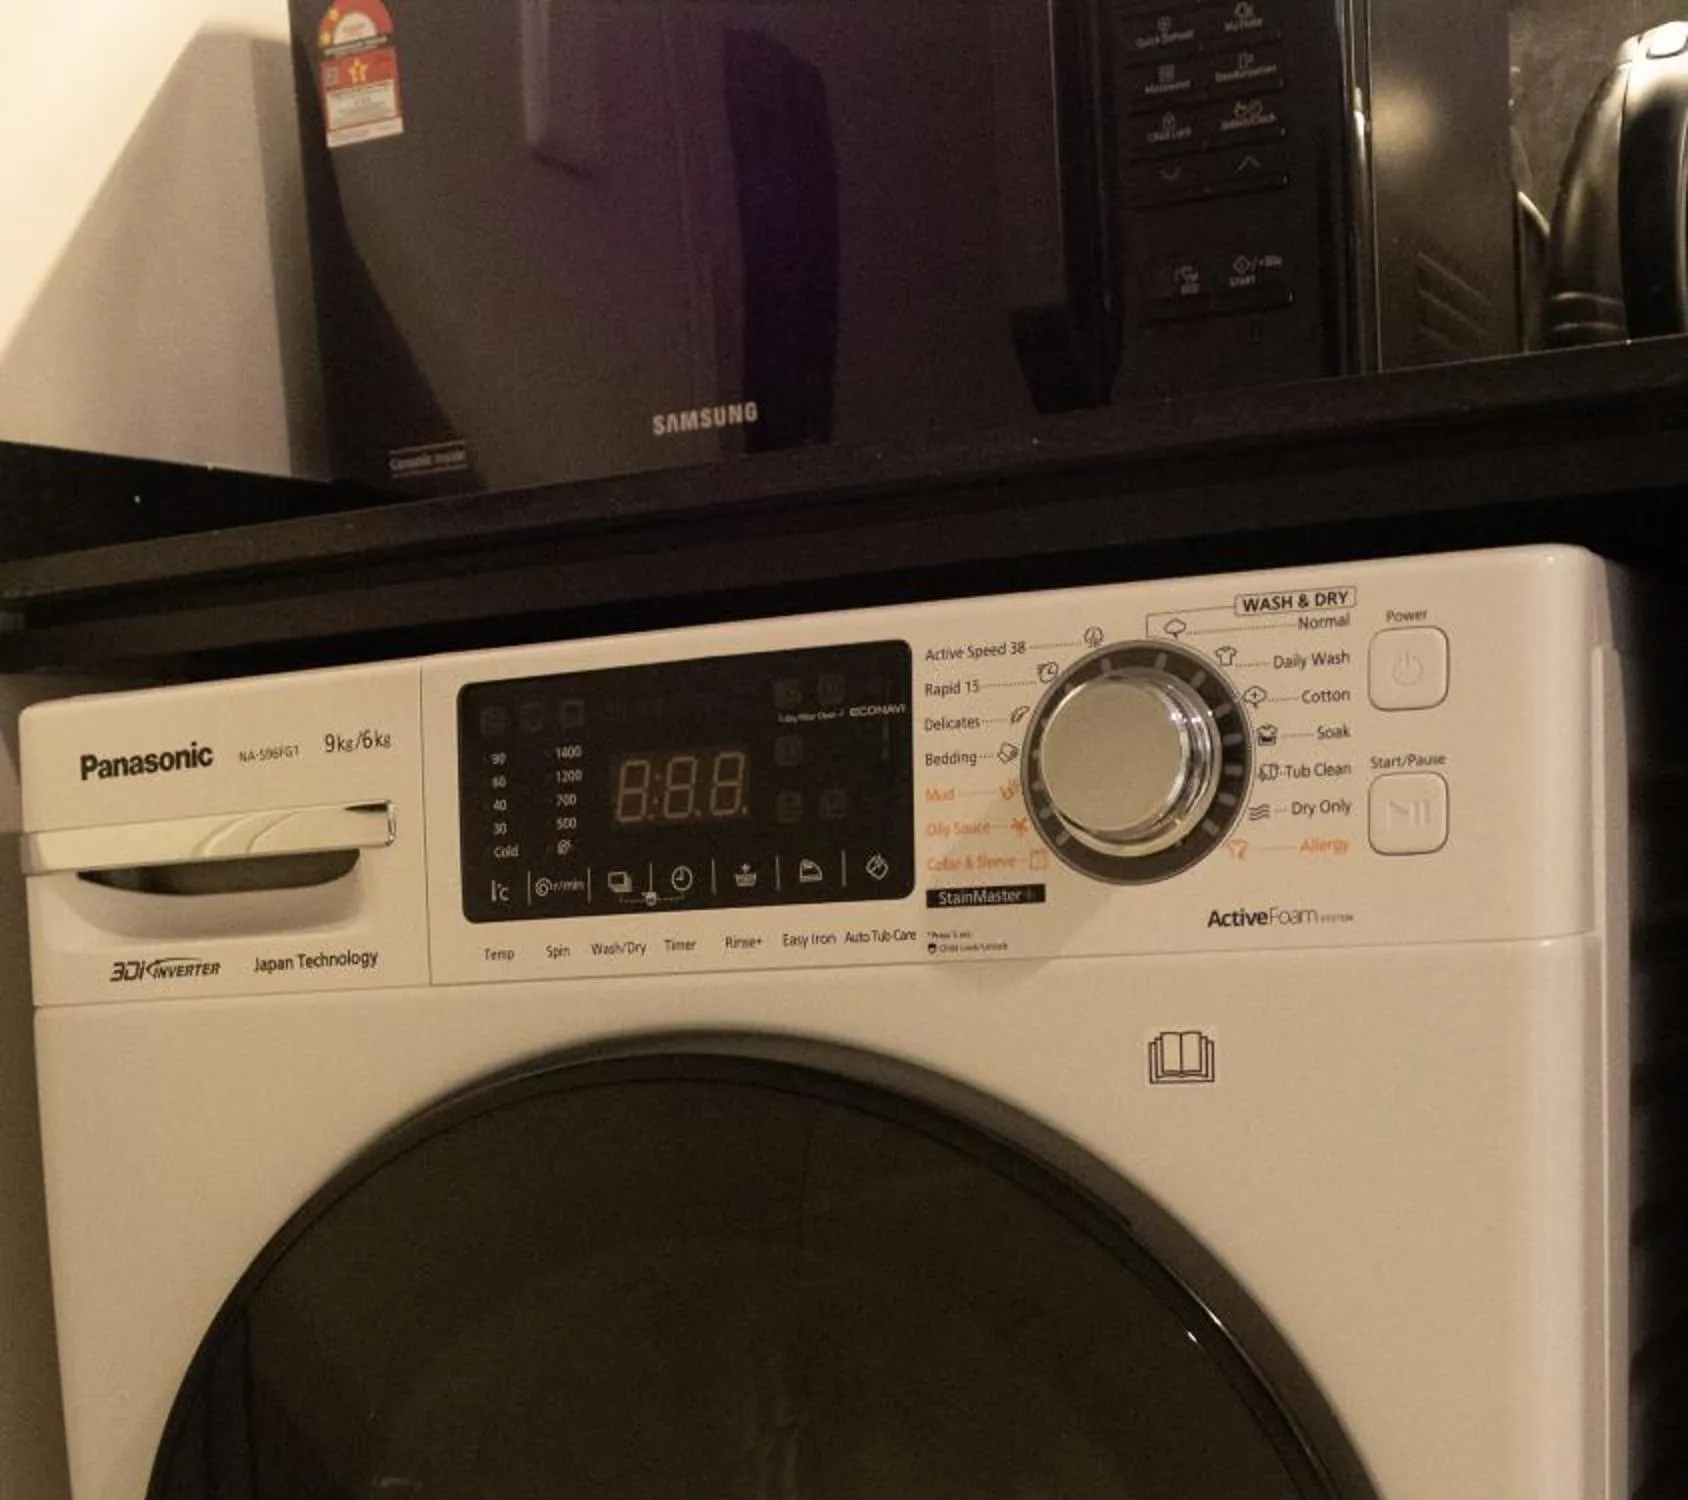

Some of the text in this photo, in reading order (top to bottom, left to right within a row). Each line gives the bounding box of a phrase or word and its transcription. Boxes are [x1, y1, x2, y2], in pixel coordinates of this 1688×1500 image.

[652, 401, 758, 436] SAMSUNG
[1243, 591, 1349, 613] WASH & DRY
[1298, 614, 1350, 630] Normal
[1386, 609, 1428, 623] Power
[925, 640, 1026, 662] Active Speed 38
[1273, 650, 1350, 670] Daily Wash
[925, 681, 961, 699] Rapid
[1301, 689, 1350, 705] Cotton
[924, 716, 981, 732] Delicates
[1317, 723, 1350, 740] Soak
[556, 745, 583, 760] 1400
[925, 751, 977, 767] Bedding
[80, 741, 214, 781] Panasonic
[1370, 753, 1447, 770] Start/Pause
[556, 769, 583, 784] 1200
[1286, 761, 1351, 779] Tub Clean
[926, 787, 955, 802] Mud
[493, 798, 508, 812] 40
[1291, 797, 1352, 819] Dry Only
[493, 821, 508, 836] 30
[556, 817, 577, 831] 500
[493, 843, 520, 859] Cold
[1301, 837, 1349, 855] Allergy
[1207, 906, 1319, 929] ActiveFoam
[725, 937, 763, 950] Rinse+
[782, 932, 837, 950] Easy Iron
[844, 928, 917, 944] Auto Tub Care
[545, 944, 571, 960] Spin
[591, 940, 647, 957] Wash/Dry
[664, 938, 697, 952] Timer
[254, 949, 380, 975] Japan Technology
[484, 947, 515, 961] Temp
[152, 961, 221, 980] INVERTER
